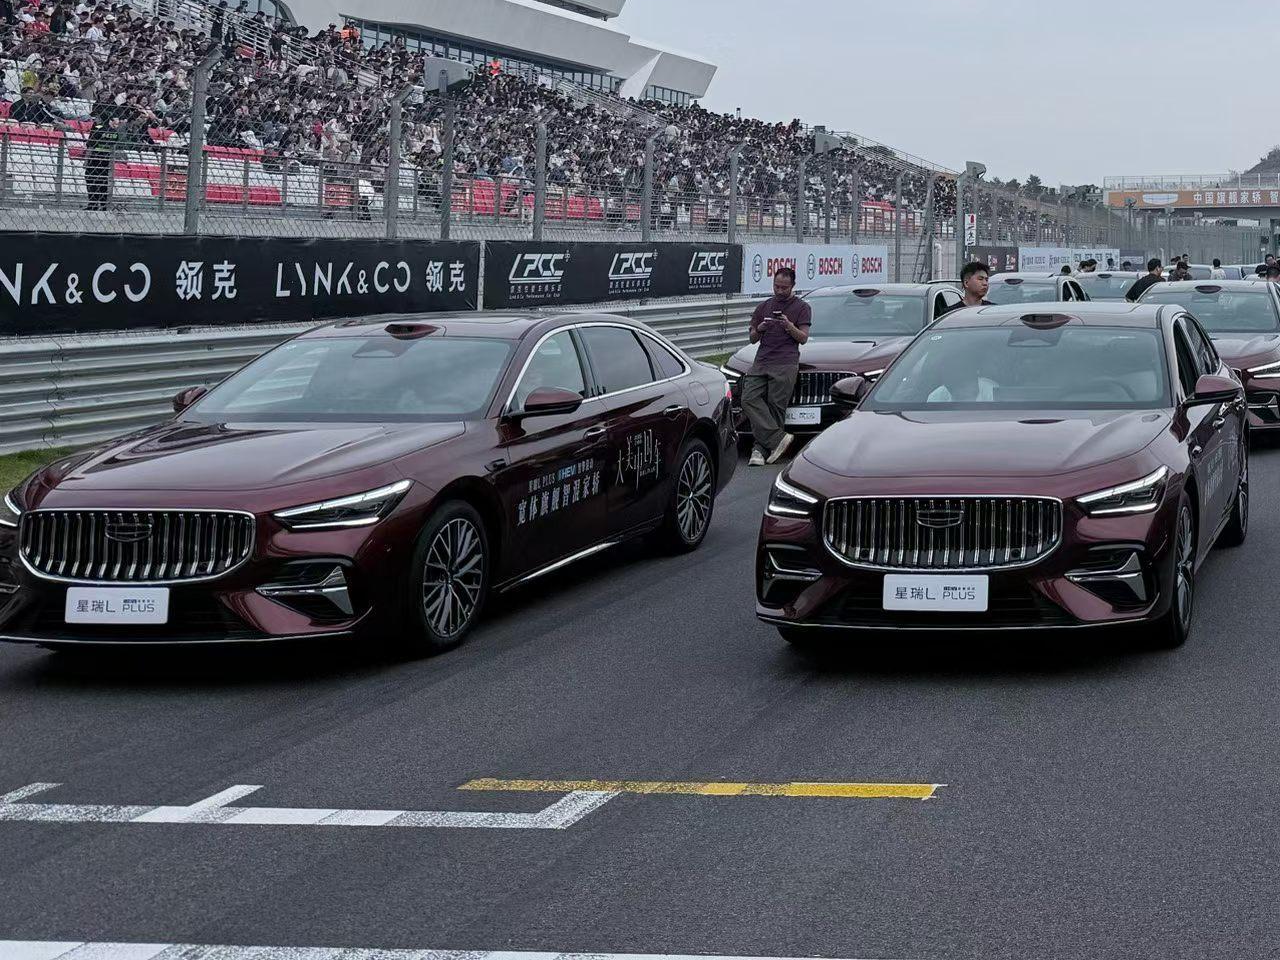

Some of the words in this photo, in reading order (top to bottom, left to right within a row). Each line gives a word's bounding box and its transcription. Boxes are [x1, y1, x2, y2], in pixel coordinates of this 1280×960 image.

[1193, 191, 1262, 204] 中国旗舰家轿
[819, 257, 843, 275] BOSCH
[861, 257, 883, 274] BOSCH
[175, 260, 237, 301] 领克
[425, 260, 466, 292] 领克
[895, 586, 936, 600] 星瑞L
[942, 591, 975, 600] PLUS
[76, 600, 116, 613] 星瑞L
[122, 603, 155, 613] PLUS
